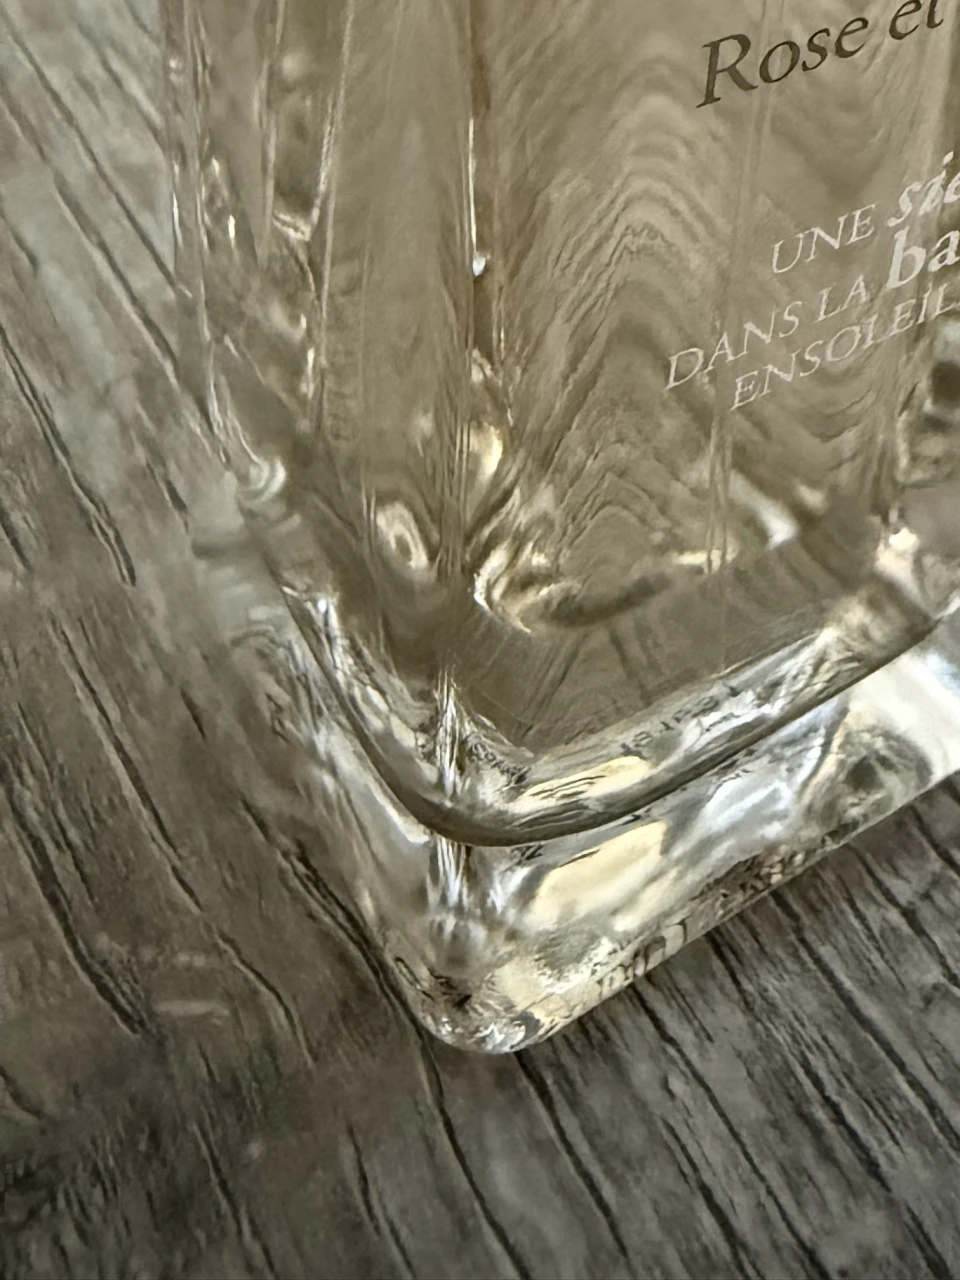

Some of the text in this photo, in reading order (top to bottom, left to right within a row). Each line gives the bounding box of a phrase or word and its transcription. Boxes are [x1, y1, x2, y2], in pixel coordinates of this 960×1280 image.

[695, 16, 869, 109] Rose
[772, 203, 876, 274] UNE
[664, 301, 802, 391] DANS
[814, 274, 872, 322] LA
